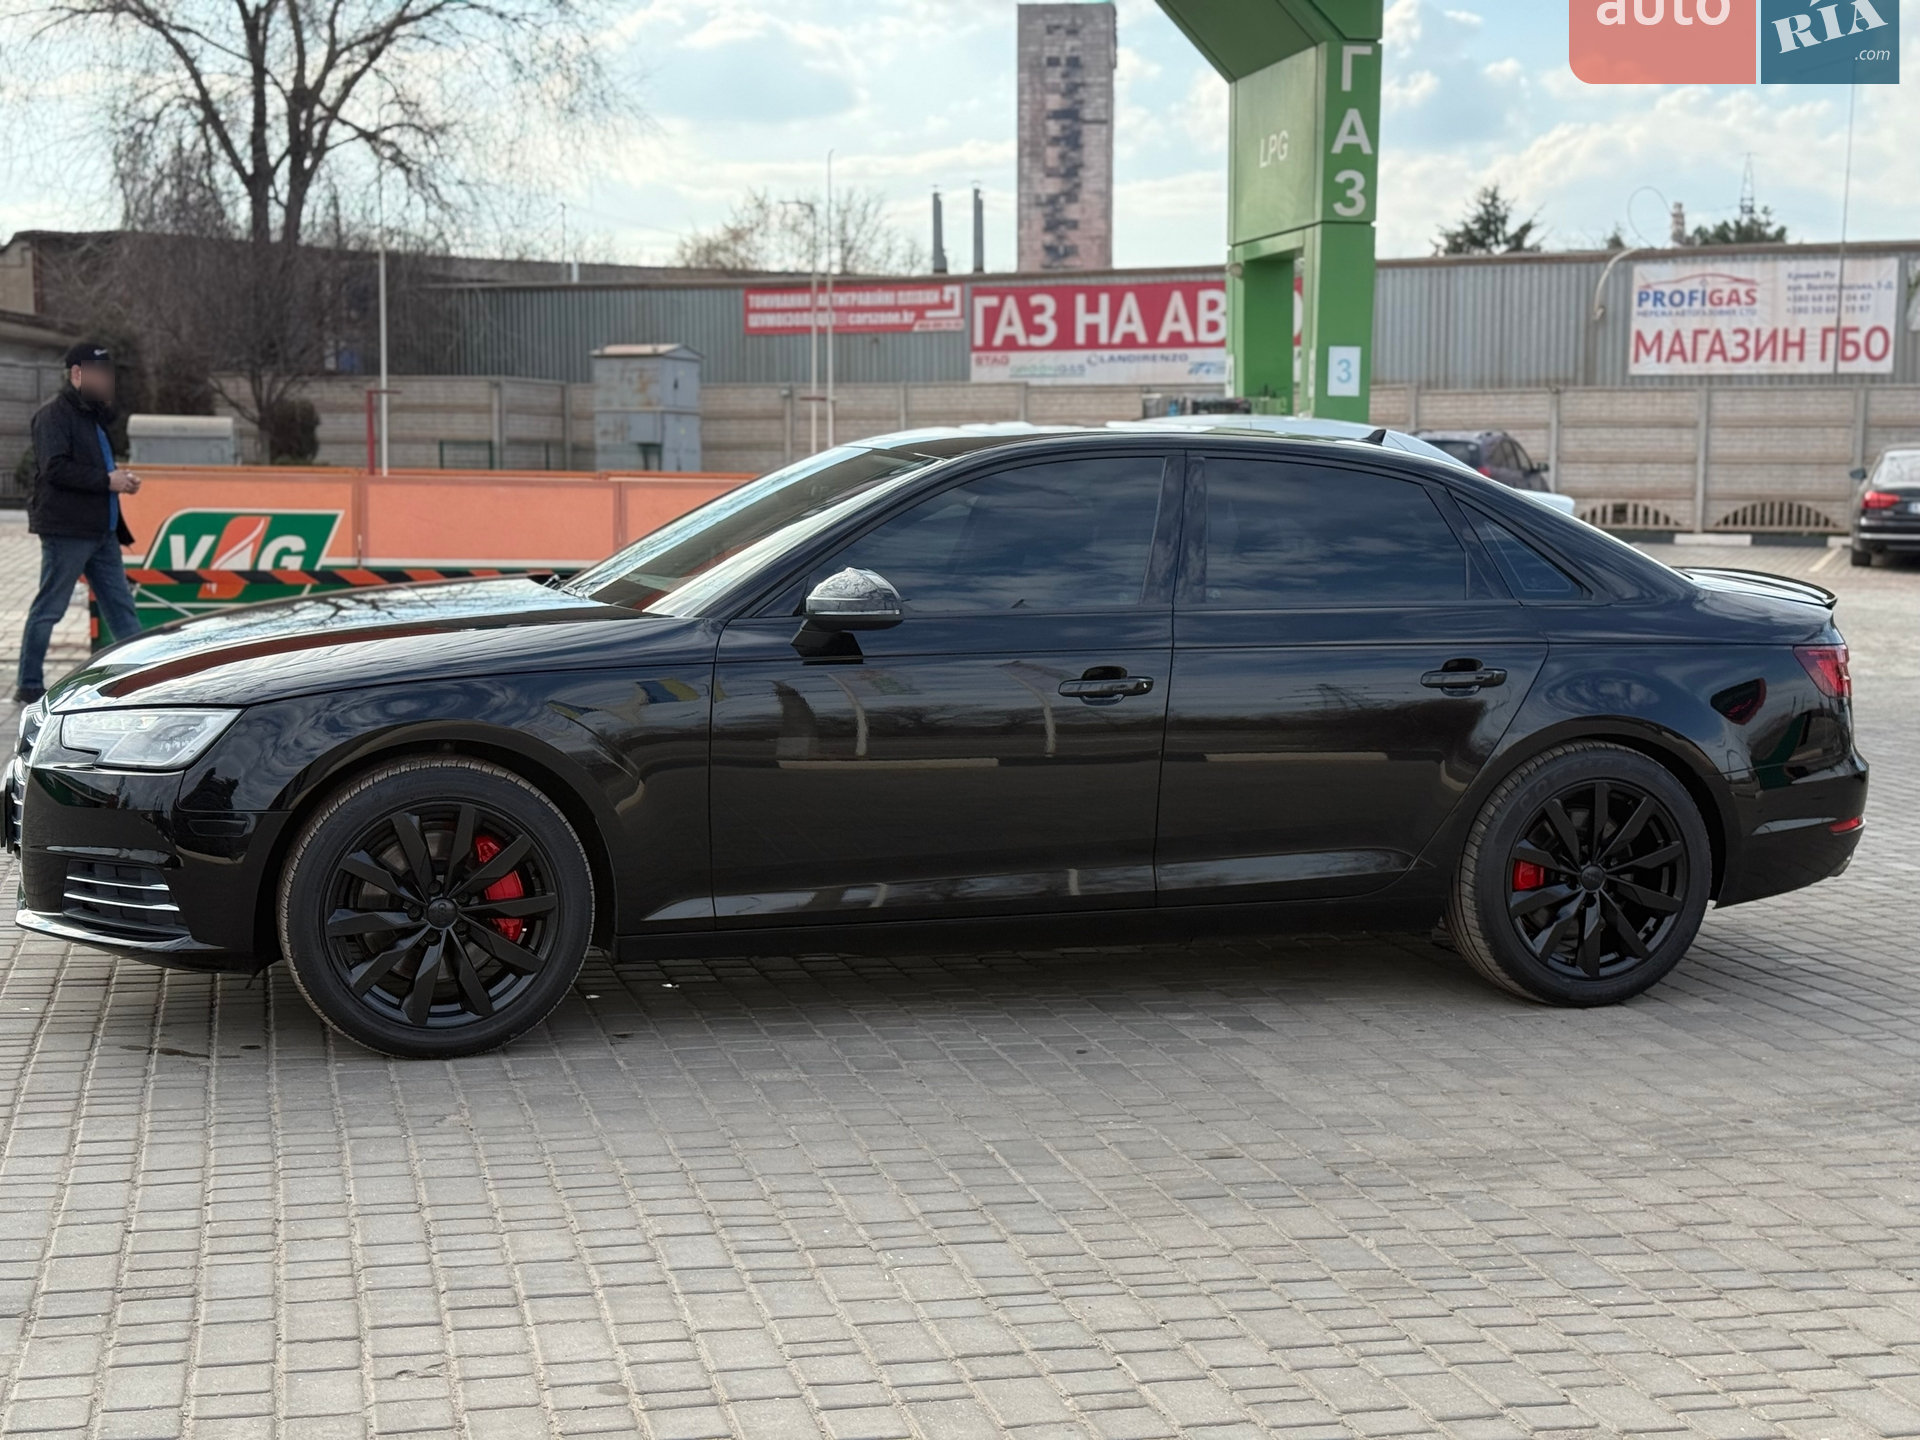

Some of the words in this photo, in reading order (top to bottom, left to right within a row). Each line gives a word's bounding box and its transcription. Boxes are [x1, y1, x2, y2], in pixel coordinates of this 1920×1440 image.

[1259, 130, 1289, 169] LPG
[1330, 45, 1374, 217] ГАЗ
[1637, 287, 1757, 308] PROFIGAS
[972, 293, 1059, 347] ГАЗ
[1074, 291, 1148, 345] НА
[1633, 327, 1806, 364] МАГАЗИН
[1818, 325, 1891, 363] ГБО
[1336, 358, 1352, 384] 3
